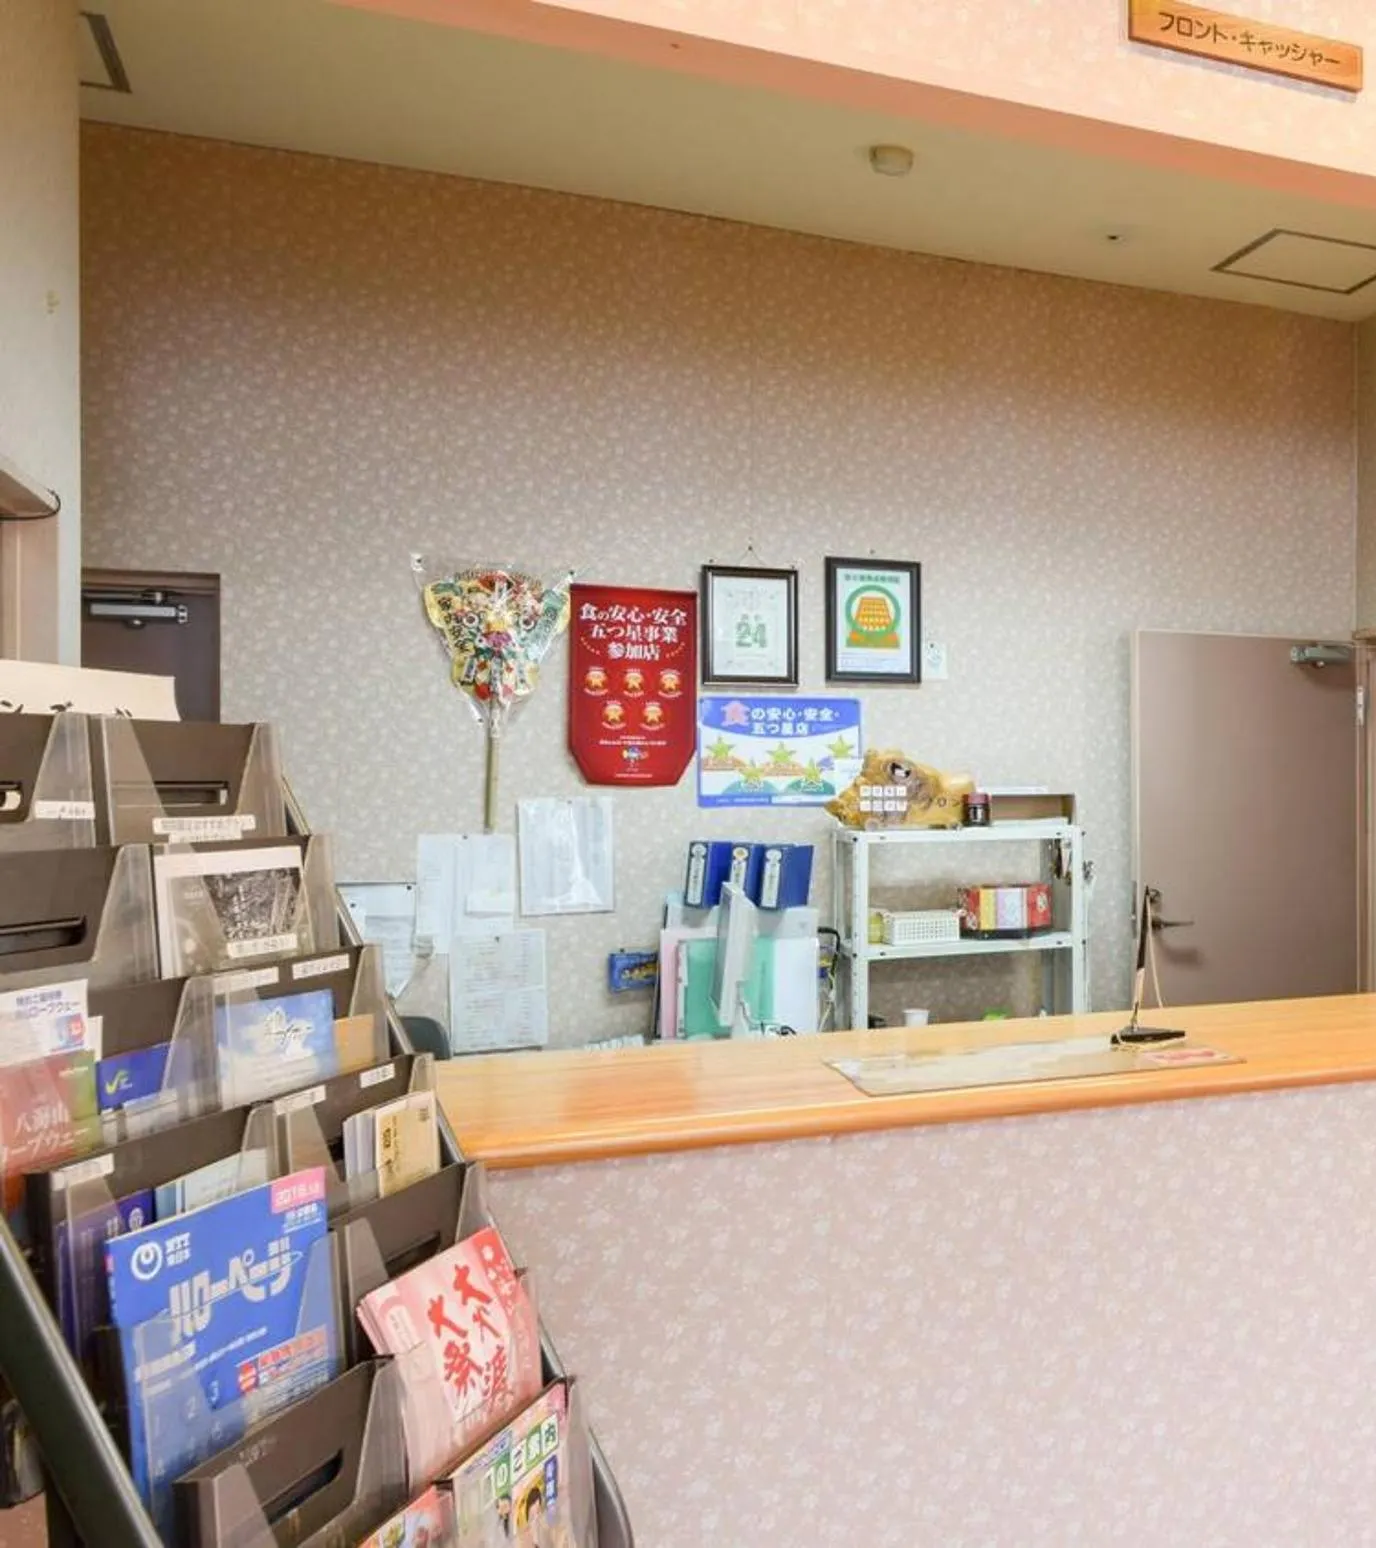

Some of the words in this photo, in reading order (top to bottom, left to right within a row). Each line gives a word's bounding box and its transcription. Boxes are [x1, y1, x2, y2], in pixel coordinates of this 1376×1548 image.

[1157, 11, 1341, 66] フロント・キャッシャー
[579, 602, 688, 626] 食の安心・安全
[591, 624, 679, 644] 五つ星事業
[607, 642, 661, 661] 参加店
